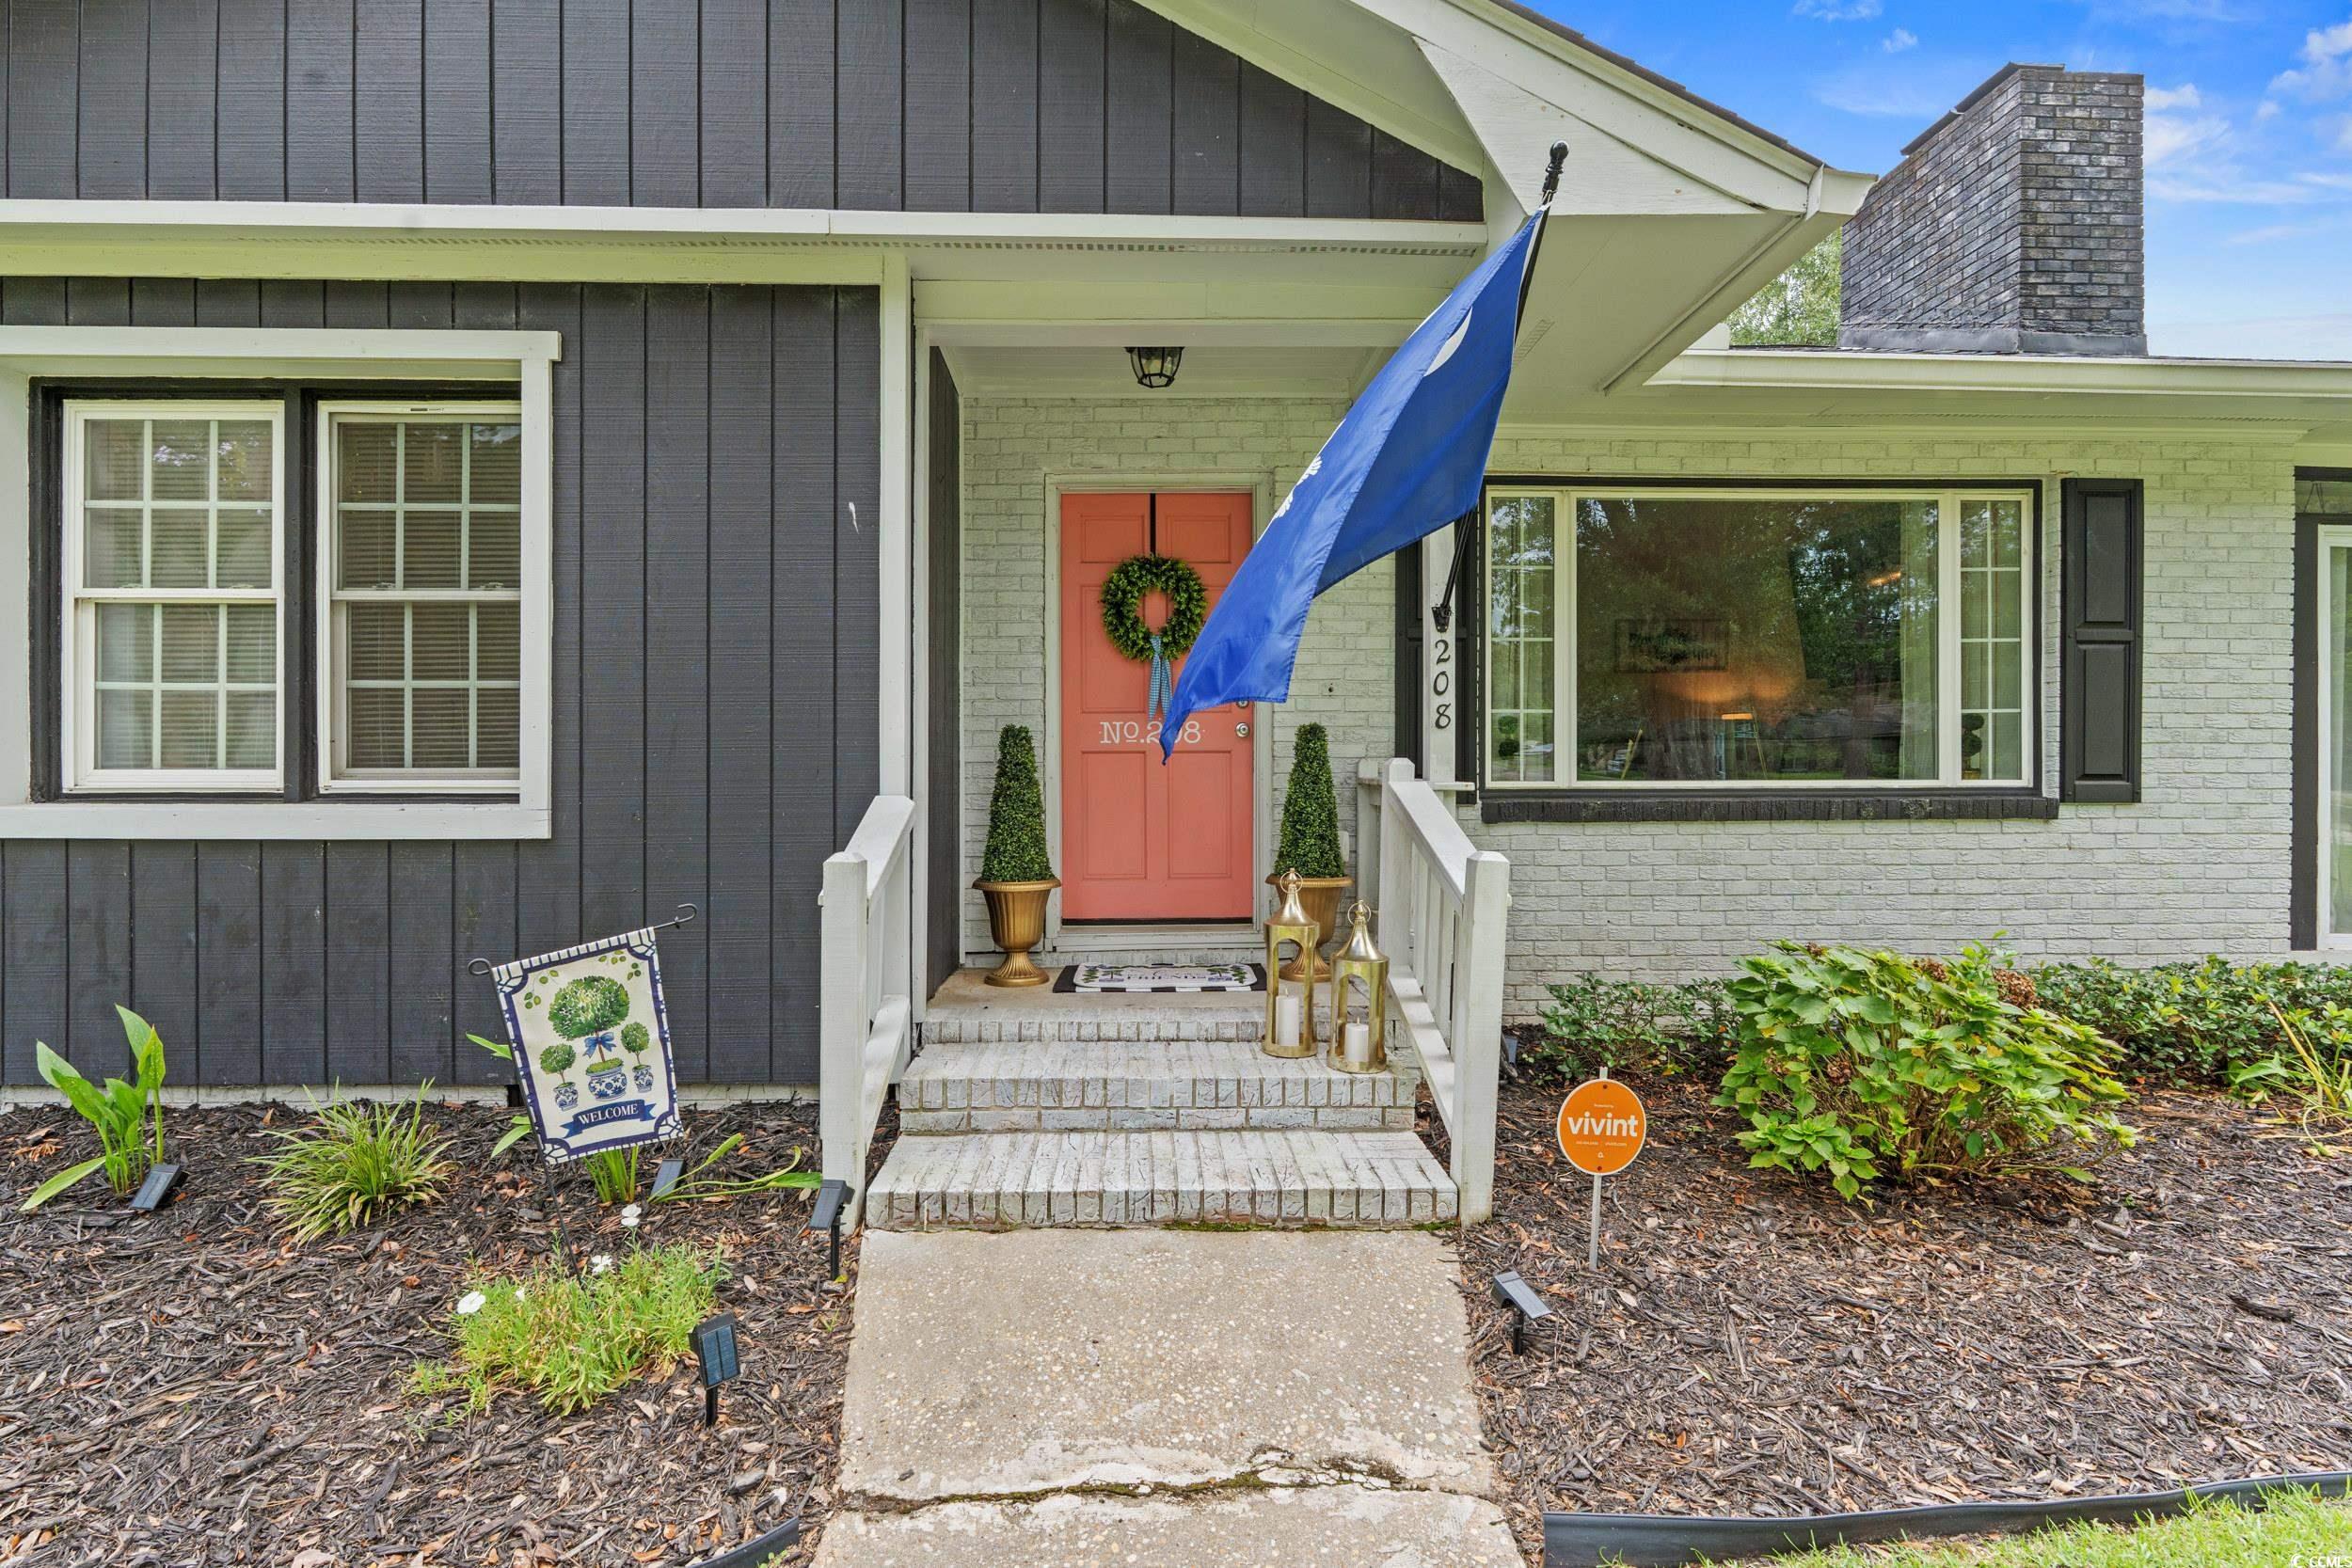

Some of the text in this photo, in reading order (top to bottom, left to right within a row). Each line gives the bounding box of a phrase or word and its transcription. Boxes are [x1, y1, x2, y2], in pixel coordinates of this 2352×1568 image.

[1433, 640, 1451, 729] 208
[1099, 721, 1201, 743] No.28
[578, 1103, 639, 1125] WELCOME
[1567, 1111, 1638, 1137] vivint
